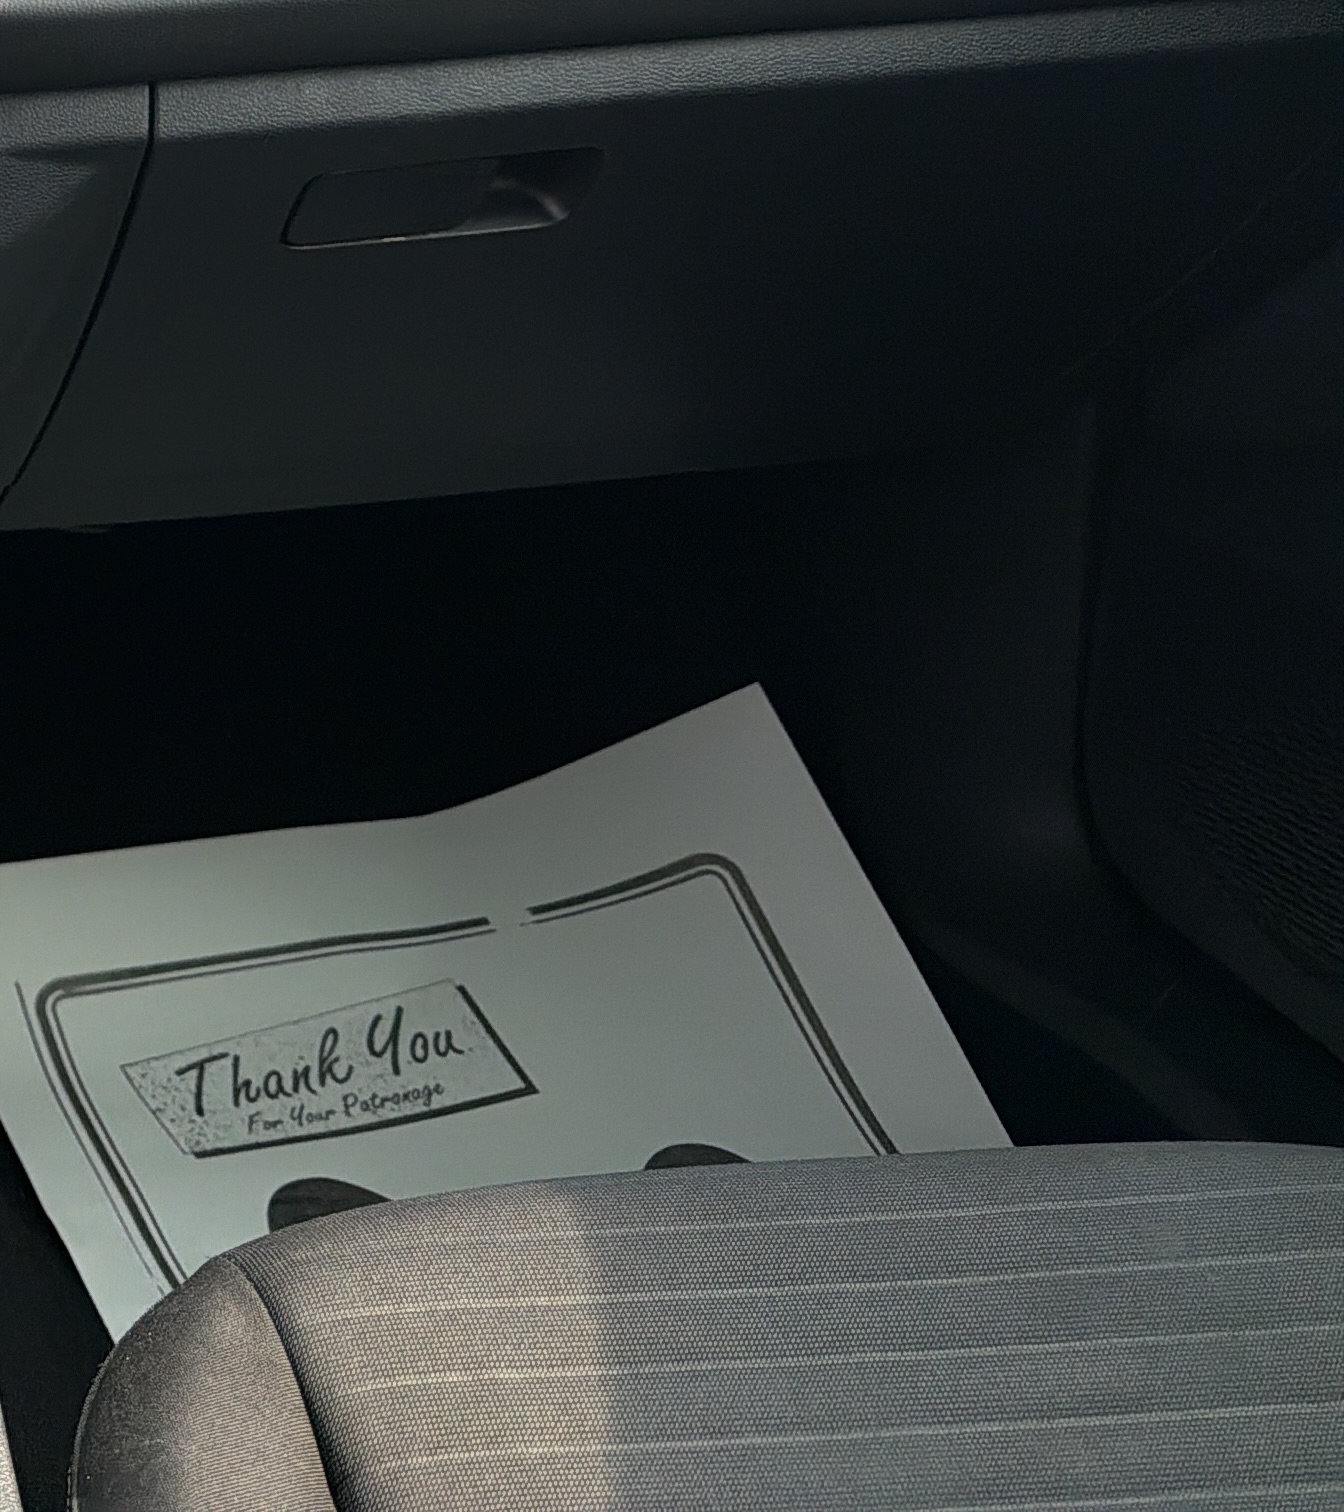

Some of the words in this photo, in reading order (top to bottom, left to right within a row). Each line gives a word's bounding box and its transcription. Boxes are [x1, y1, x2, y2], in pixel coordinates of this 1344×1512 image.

[175, 1026, 353, 1117] Thank
[367, 1005, 464, 1076] You
[246, 1109, 283, 1134] For
[289, 1103, 336, 1125] Your
[342, 1083, 445, 1118] Patronage
